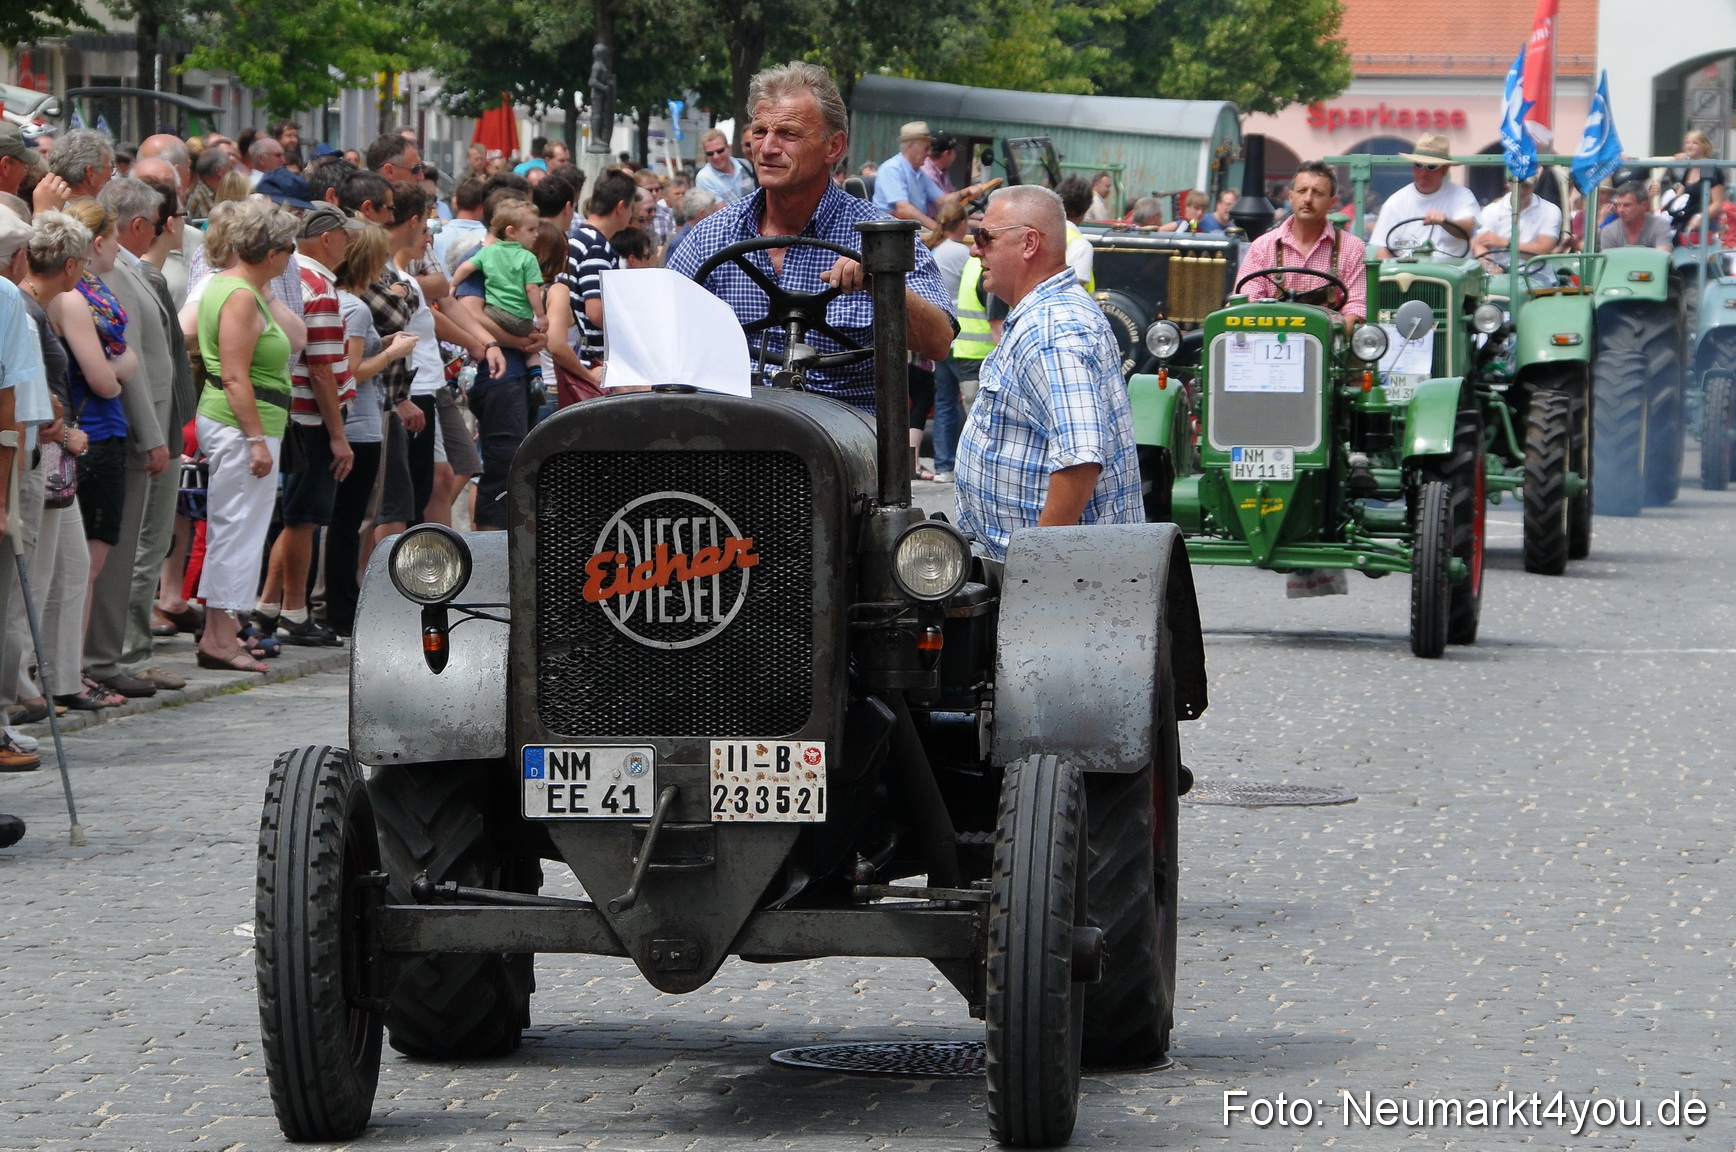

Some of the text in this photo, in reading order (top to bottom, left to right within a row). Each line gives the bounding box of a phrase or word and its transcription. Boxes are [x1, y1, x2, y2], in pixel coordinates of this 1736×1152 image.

[1307, 101, 1467, 132] Sparkasse
[1101, 303, 1139, 343] estauration
[1225, 316, 1306, 327] DEUTZ
[1265, 344, 1292, 360] 121
[1390, 376, 1407, 387] NM
[1244, 449, 1264, 463] NM
[1235, 464, 1277, 478] HY 11
[582, 536, 760, 603] Eicher
[617, 516, 726, 624] DIESEL
[549, 751, 591, 780] NM
[548, 784, 640, 814] EE 41
[713, 784, 824, 815] 233521
